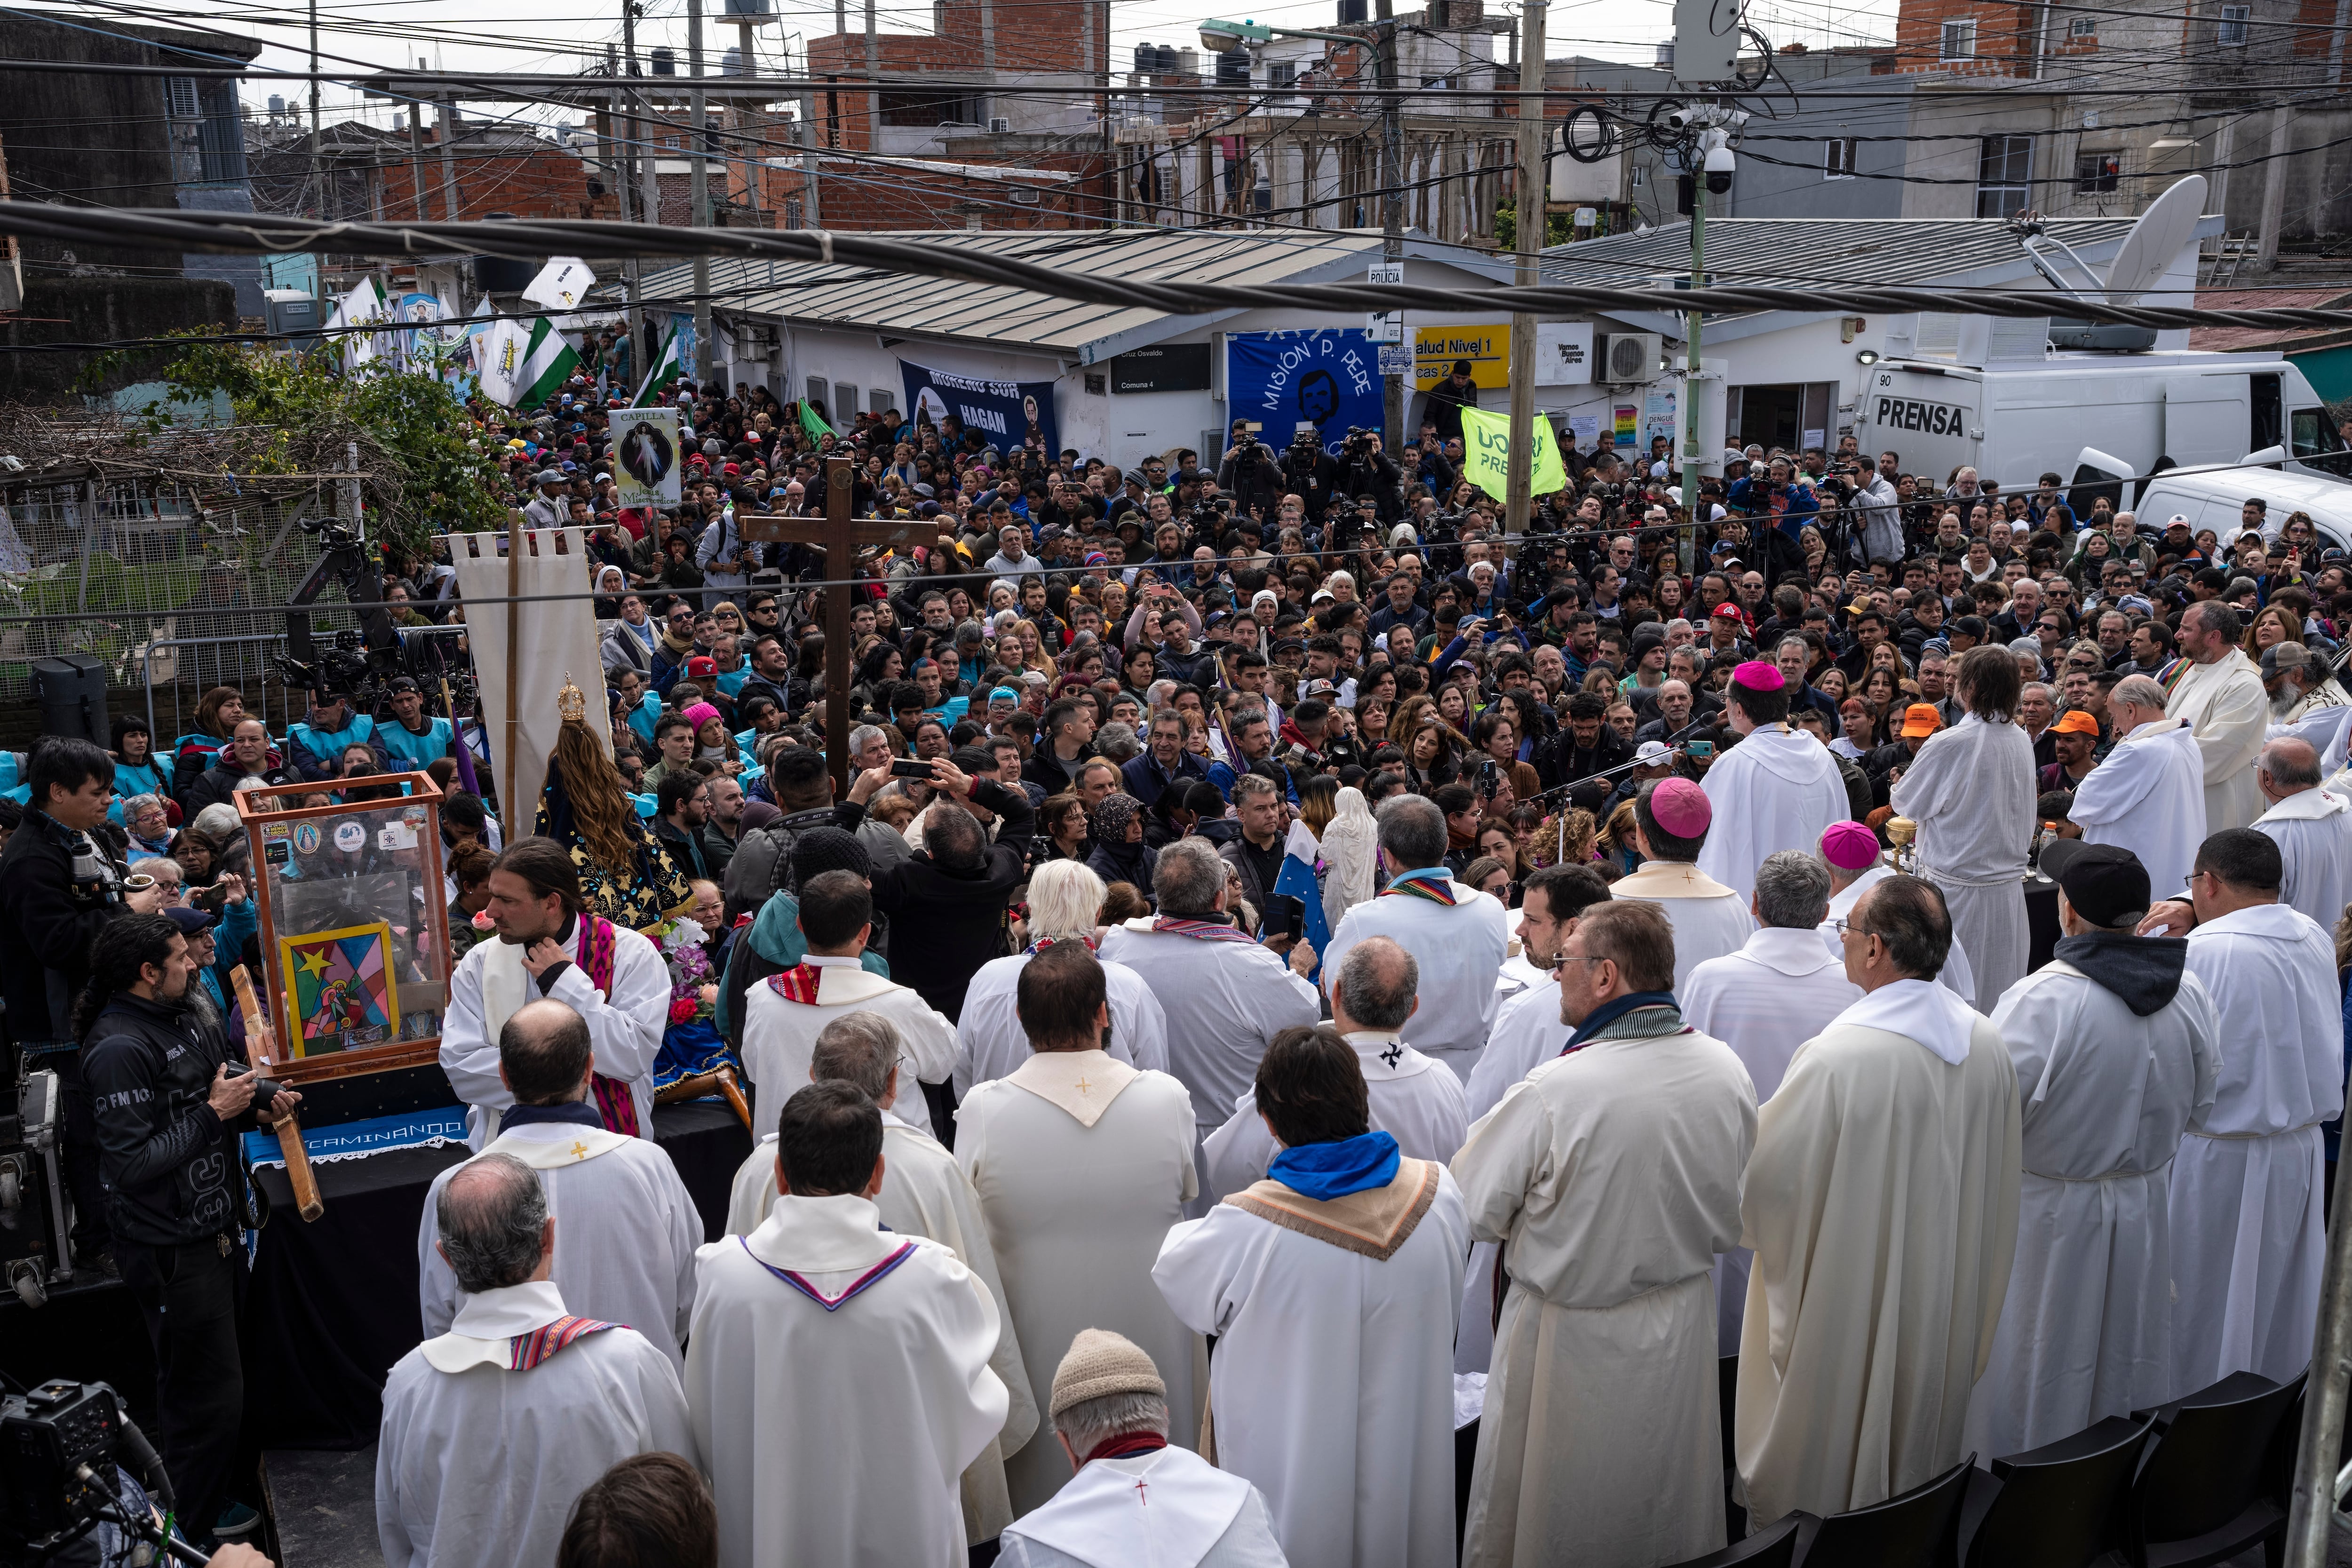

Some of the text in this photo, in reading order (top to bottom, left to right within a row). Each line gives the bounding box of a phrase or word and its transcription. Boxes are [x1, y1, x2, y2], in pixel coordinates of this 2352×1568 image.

[1371, 272, 1400, 283] POLICIA
[1416, 337, 1491, 354] alud Nivel 1
[1262, 339, 1372, 410] MISIÓN P. PEPE
[1416, 367, 1438, 378] cas
[454, 390, 467, 400] OSE
[620, 413, 666, 422] CAPILLA
[960, 405, 1007, 435] HAGAN
[1877, 398, 1963, 437] PRENSA
[1477, 426, 1543, 458] UORA
[622, 493, 678, 504] Misericordioso
[636, 484, 659, 496] Jesús
[109, 1090, 130, 1108] FM
[309, 1122, 461, 1149] CAMINANDO
